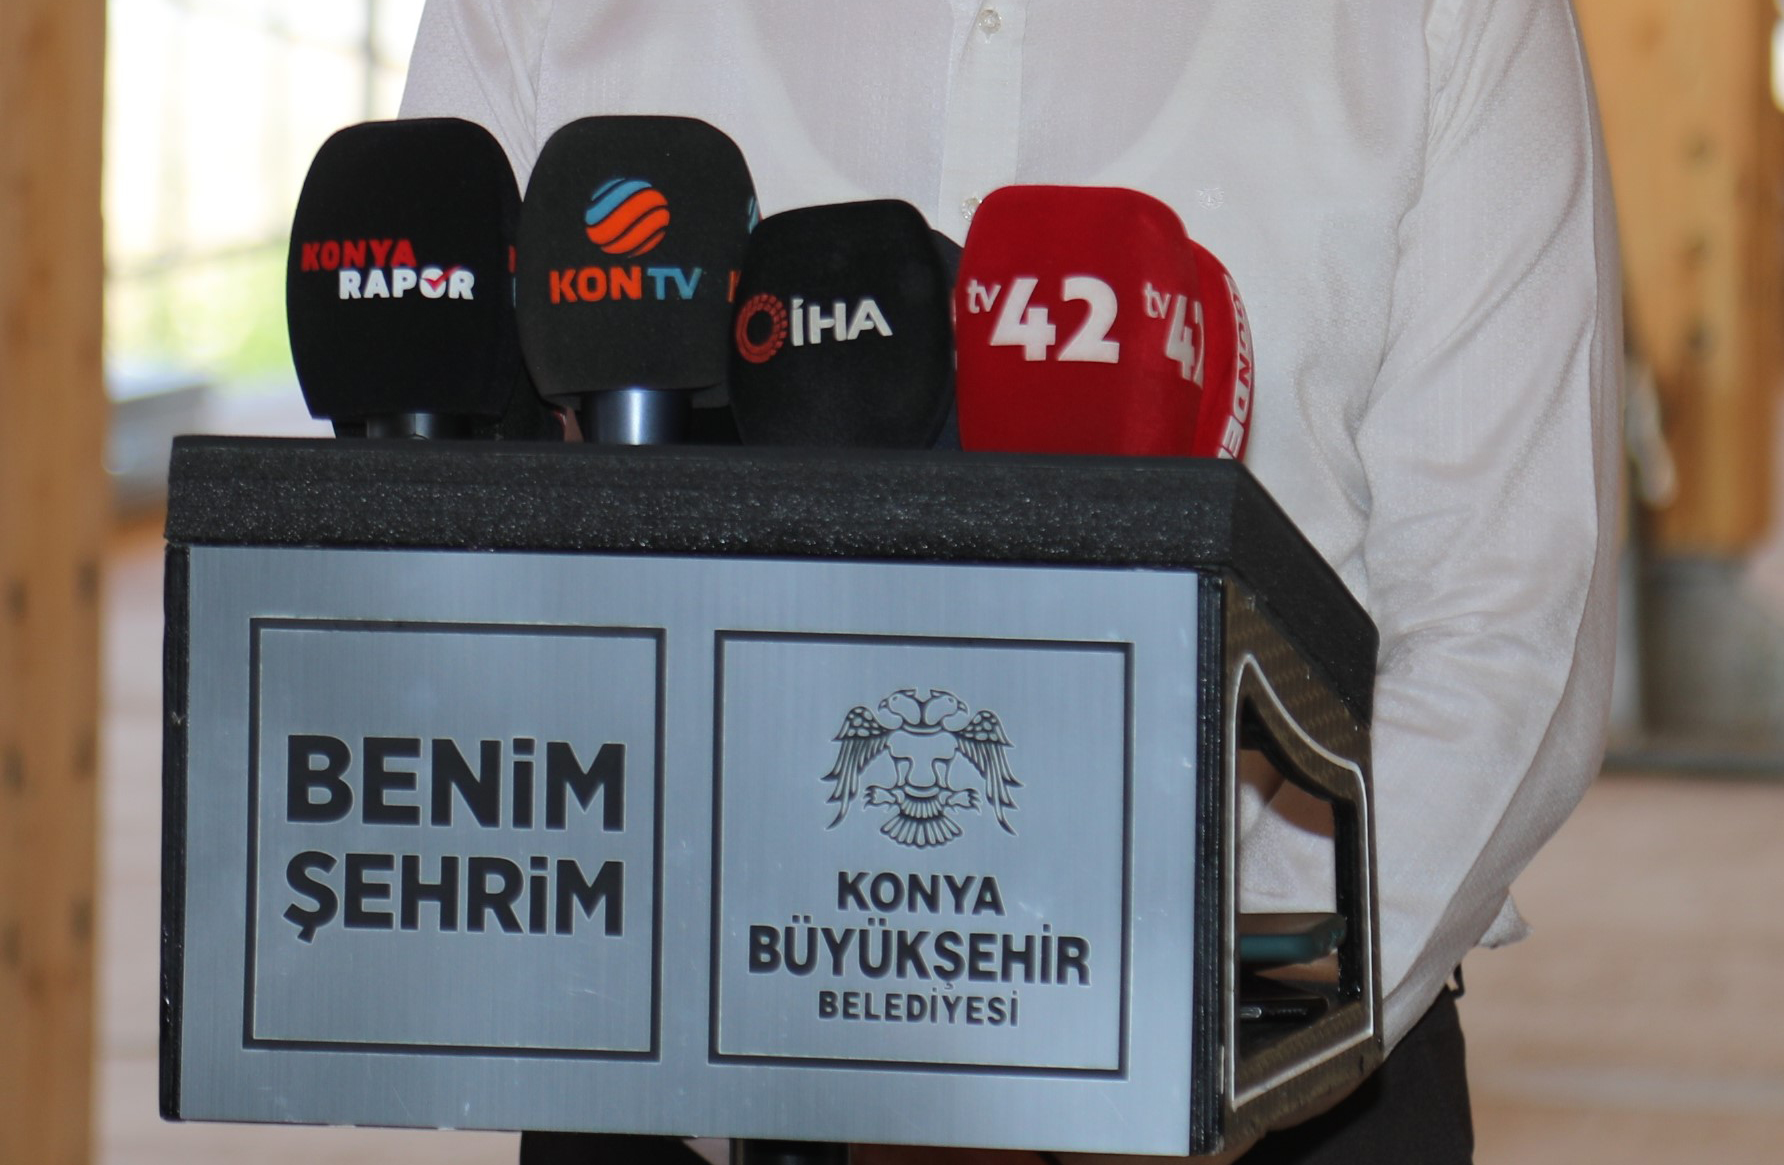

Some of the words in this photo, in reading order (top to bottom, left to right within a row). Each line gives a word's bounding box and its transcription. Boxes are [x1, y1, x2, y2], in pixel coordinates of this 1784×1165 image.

[302, 239, 416, 271] KONYA
[339, 267, 474, 299] RAPOR
[549, 266, 642, 304] KON
[647, 267, 701, 300] TV
[967, 279, 1000, 313] tv
[990, 276, 1120, 363] 42
[837, 871, 1005, 916] KONYA
[748, 915, 1091, 988] BÜYÜKŞEHİR
[818, 986, 1020, 1027] BELEDİYESİ
